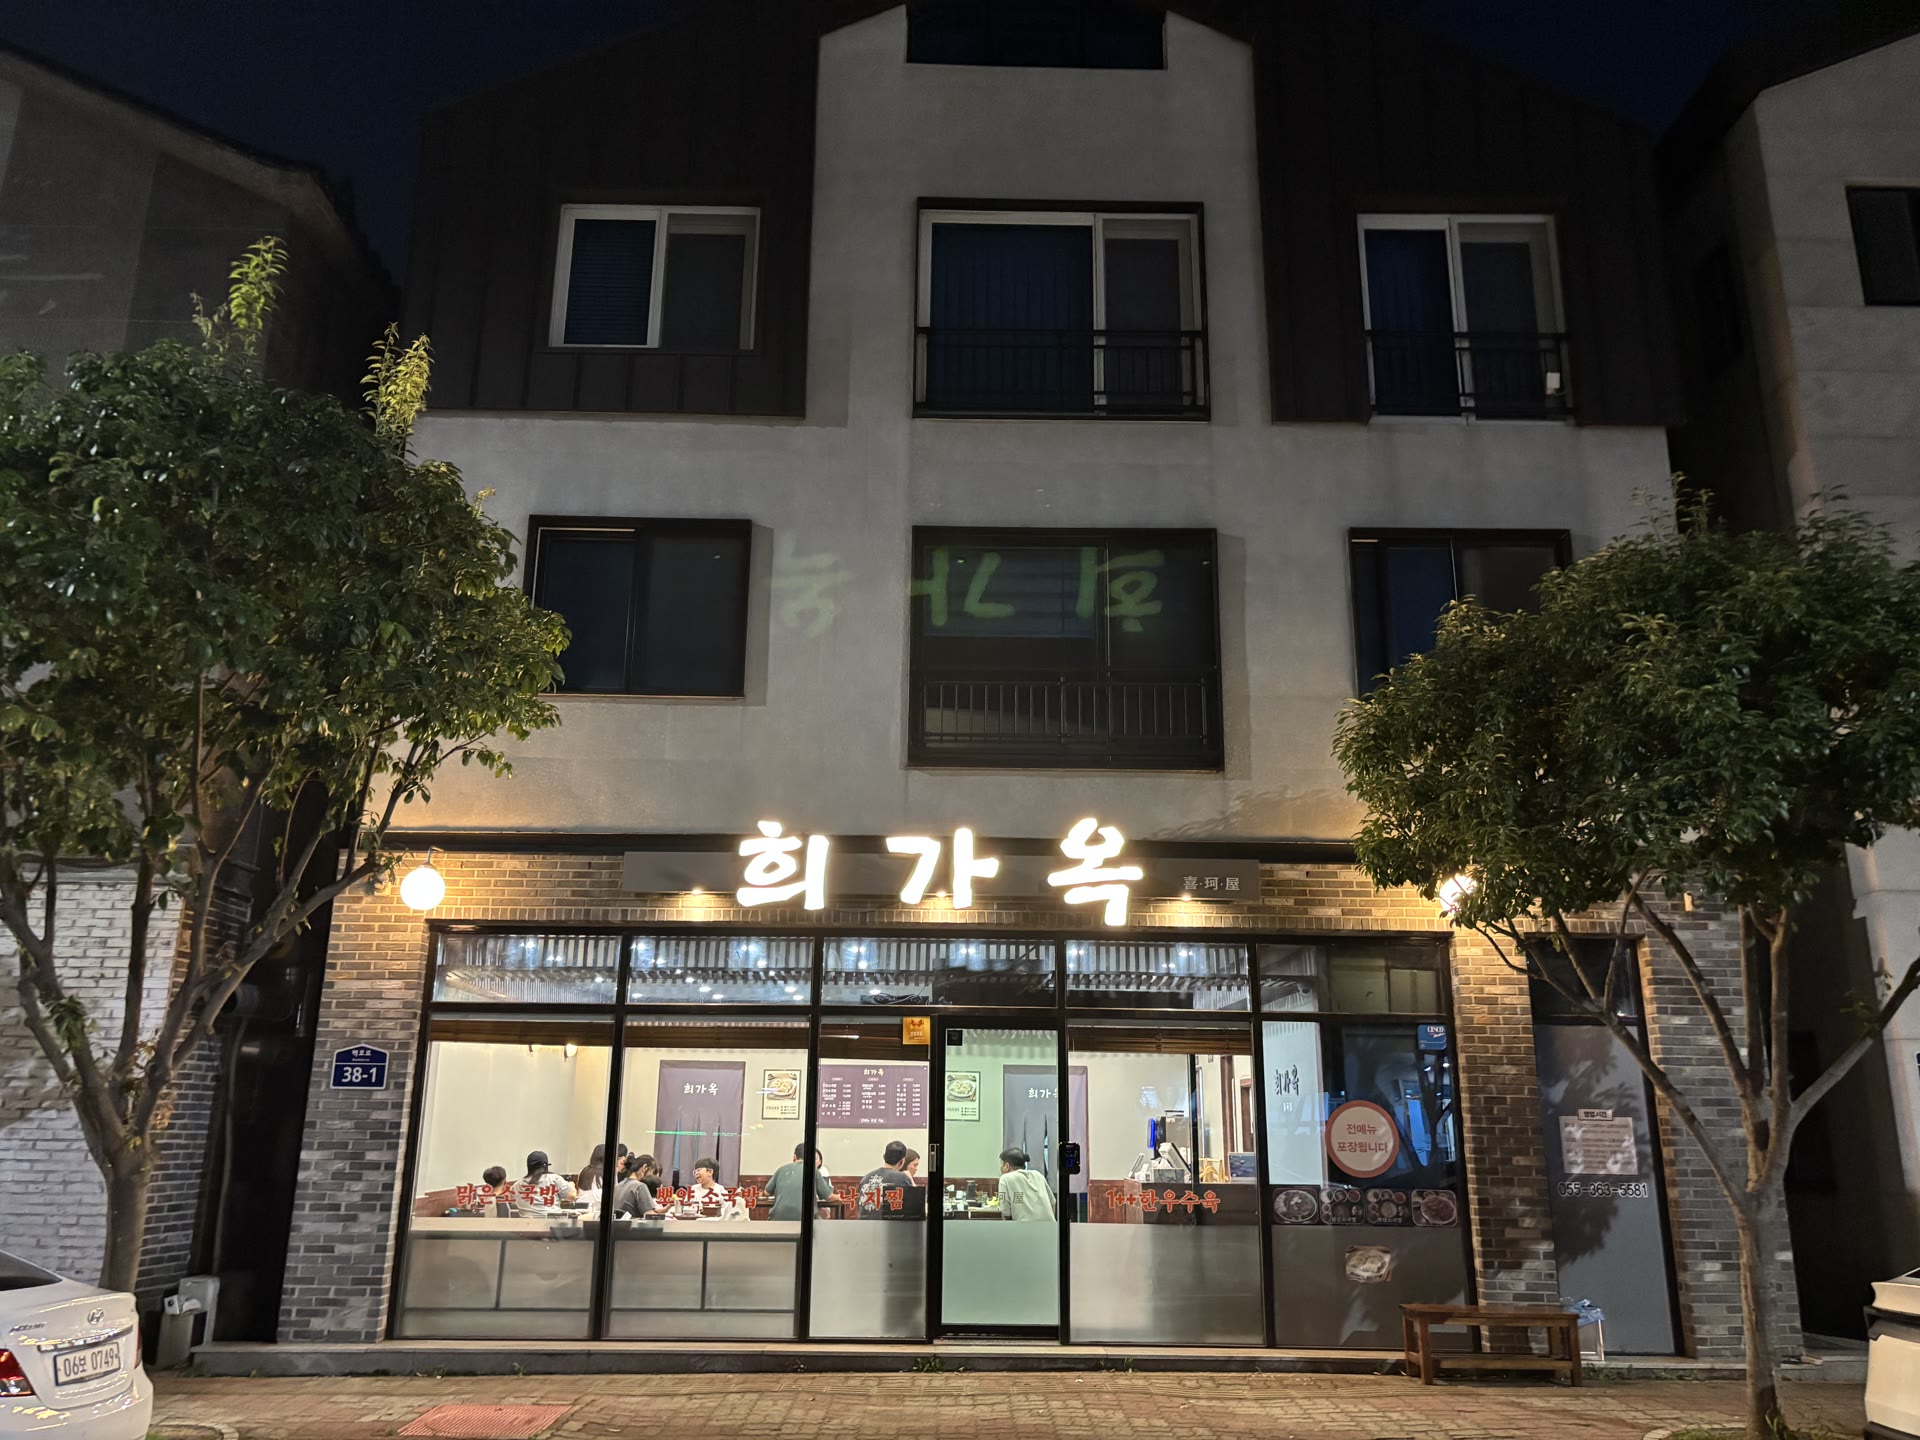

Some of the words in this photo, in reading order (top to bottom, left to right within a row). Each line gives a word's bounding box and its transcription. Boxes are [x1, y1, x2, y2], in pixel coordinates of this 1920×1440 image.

[737, 817, 1144, 927] 희가옥
[341, 1067, 377, 1083] 38-1
[683, 1082, 719, 1096] 희가옥
[1346, 1123, 1377, 1135] 전메뉴
[1337, 1141, 1388, 1153] 포장됩니다
[1558, 1182, 1648, 1198] 055-363-5581
[63, 1355, 88, 1377] 06보
[91, 1347, 115, 1371] 0749
